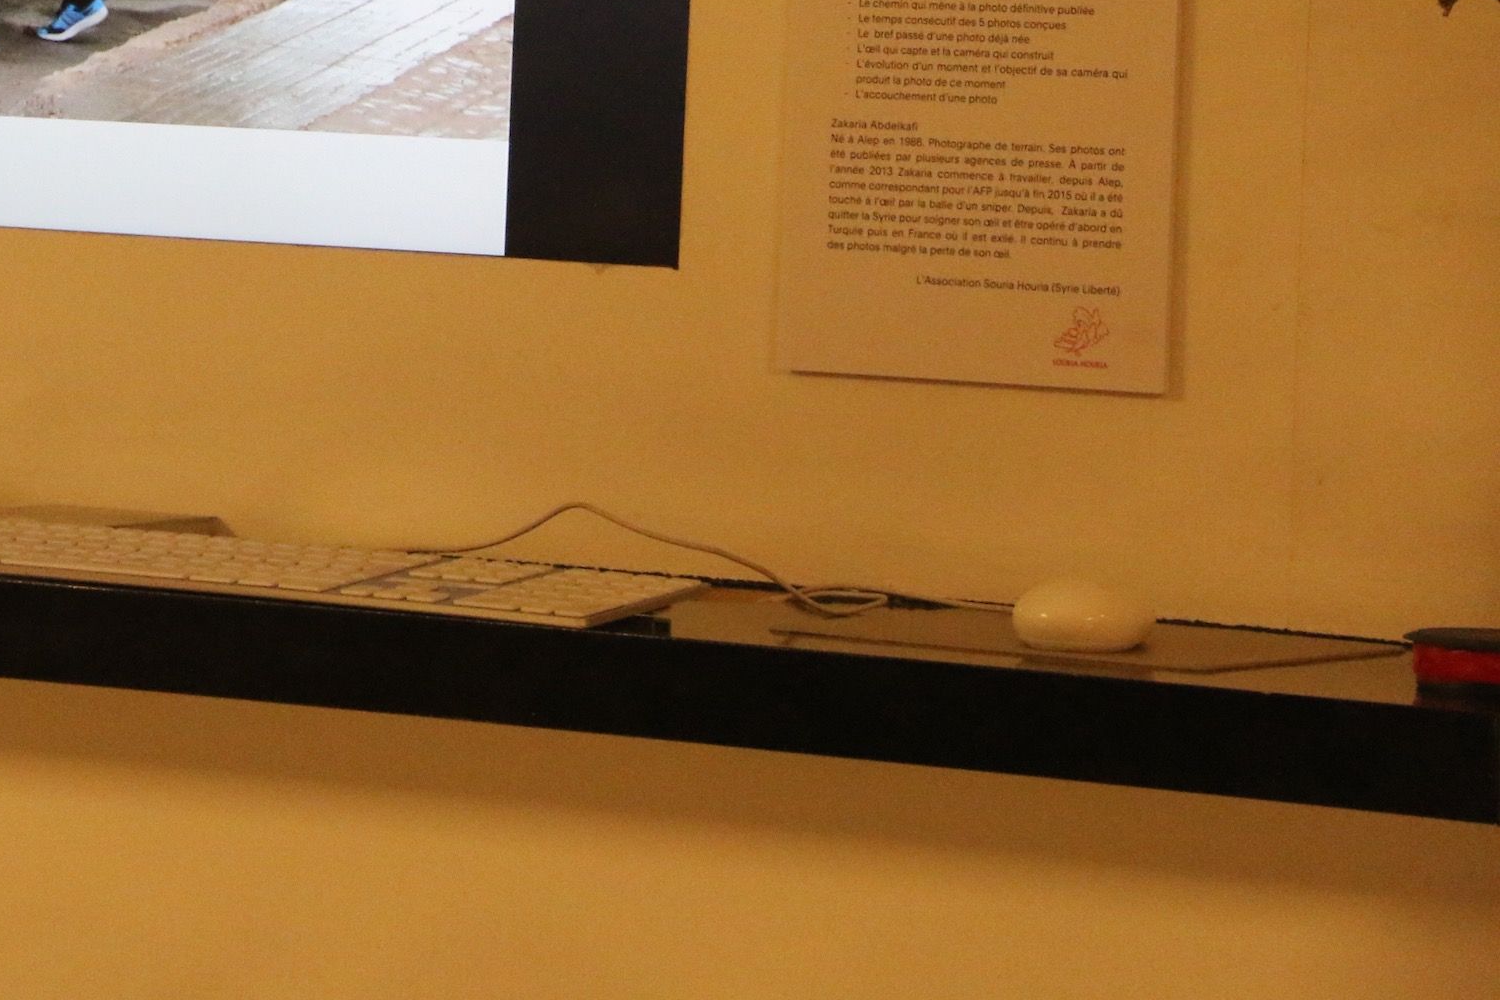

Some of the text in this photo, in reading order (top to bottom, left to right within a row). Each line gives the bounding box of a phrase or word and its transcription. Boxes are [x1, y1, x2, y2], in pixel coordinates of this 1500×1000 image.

[911, 0, 926, 12] qui
[978, 1, 1008, 15] photo
[1010, 2, 1055, 14] définitive
[872, 14, 902, 27] temps
[958, 16, 976, 27] des
[987, 17, 1021, 31] photos
[1023, 20, 1066, 32] conçues
[874, 29, 894, 39] bref
[927, 30, 954, 41] d'une
[956, 31, 985, 45] photo
[988, 32, 1009, 45] déjà
[1012, 33, 1030, 44] née
[883, 45, 898, 58] qui
[900, 46, 928, 58] capte
[953, 47, 990, 58] caméra
[993, 48, 1009, 61] qui
[1011, 49, 1054, 60] construit
[856, 59, 909, 71] L'évolution
[912, 61, 933, 72] d'un
[937, 62, 978, 73] moment
[994, 64, 1037, 77] l'objectif
[1071, 66, 1108, 77] caméra
[1112, 68, 1128, 80] qui
[856, 74, 890, 87] produit
[903, 75, 932, 89] photo
[964, 78, 1005, 89] moment
[855, 89, 997, 106] L'accouchement d'une photo
[831, 118, 918, 131] Zakaria Abdelkafi
[827, 239, 844, 250] des
[847, 240, 880, 254] photos
[883, 242, 917, 256] malgré
[930, 245, 955, 258] perte
[973, 249, 991, 258] son
[916, 275, 1120, 297] L'Association Souria Houria (Syrie Liberté)
